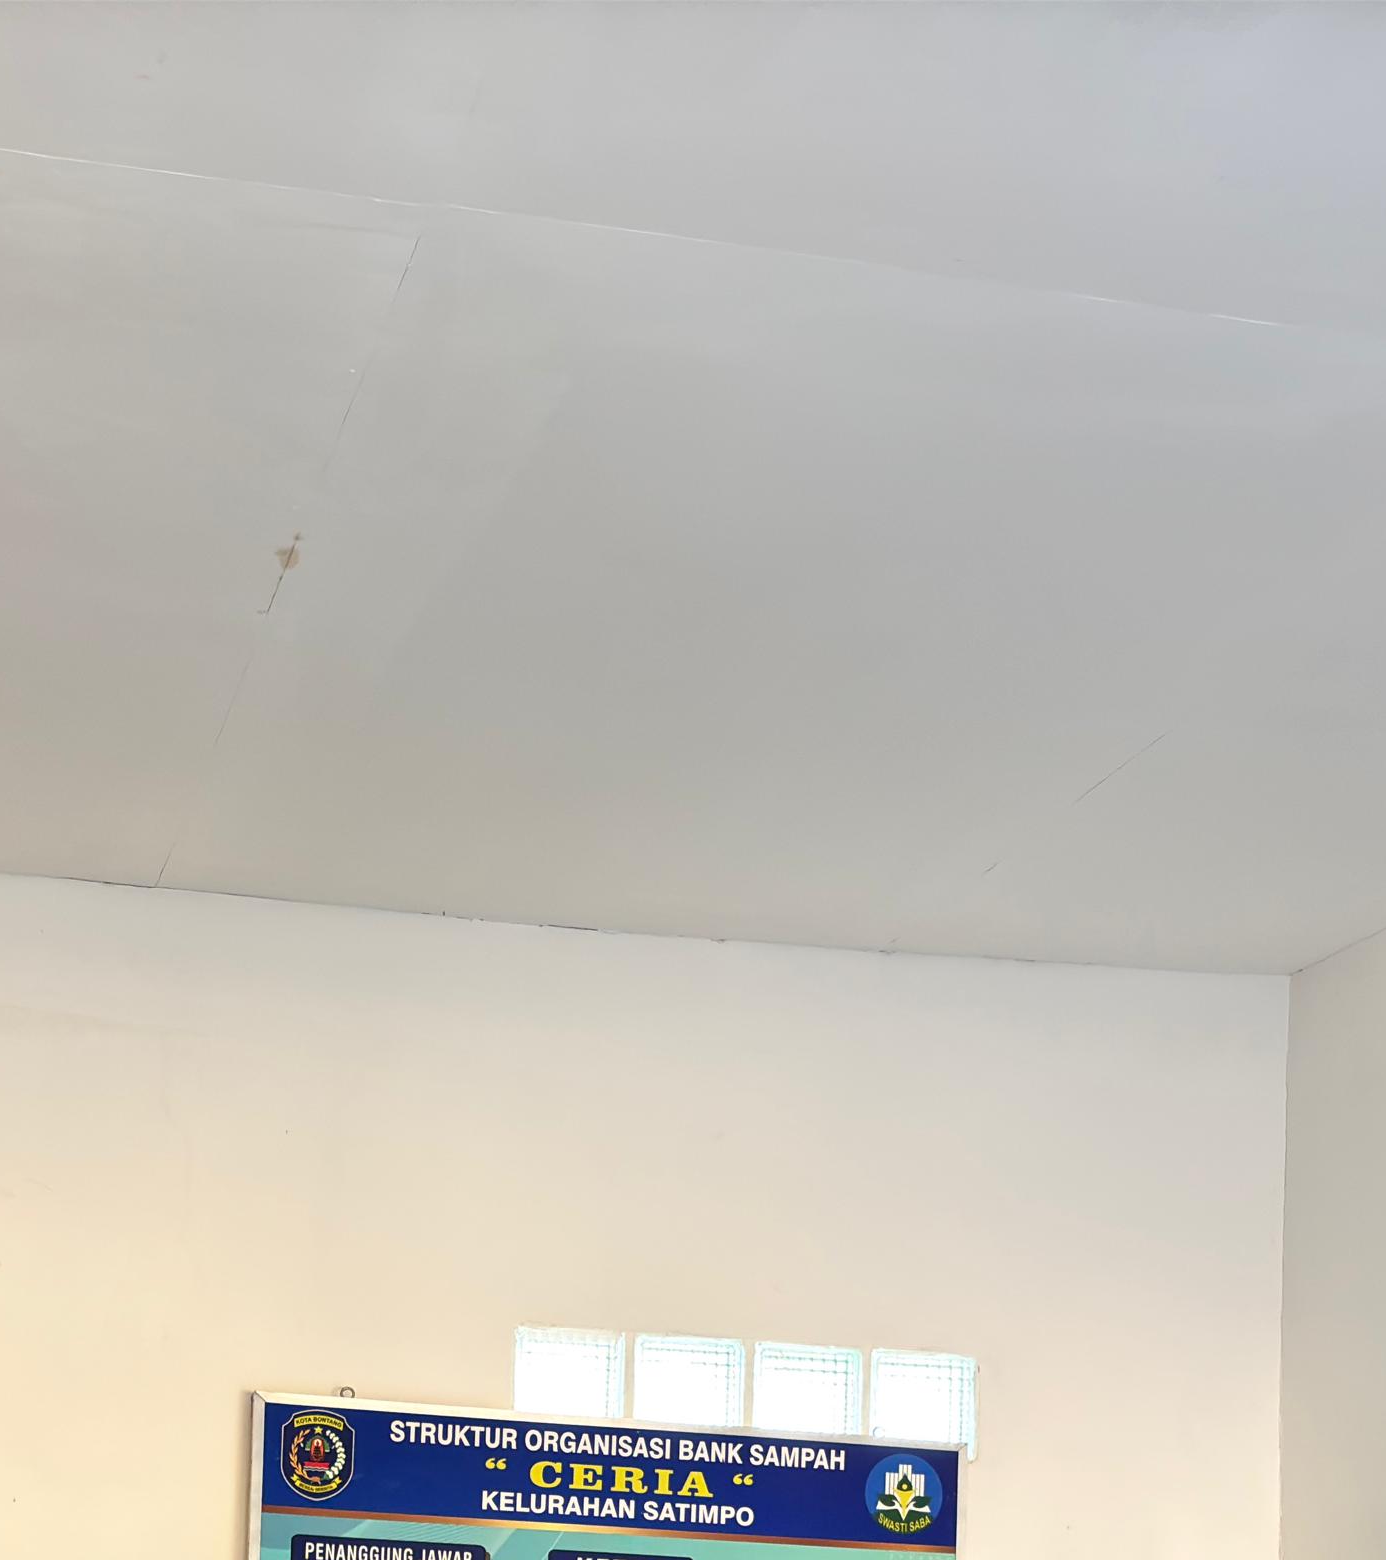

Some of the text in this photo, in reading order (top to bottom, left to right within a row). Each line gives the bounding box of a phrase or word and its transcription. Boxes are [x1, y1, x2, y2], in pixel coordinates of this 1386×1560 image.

[295, 1417, 311, 1426] KOTA
[390, 1420, 845, 1470] STRUKTUR ORGANISASI BANK SAMPAH
[530, 1460, 713, 1497] CERIA
[481, 1490, 754, 1527] KELURAHAN SATIMPO
[878, 1513, 931, 1532] SWASTI SABA
